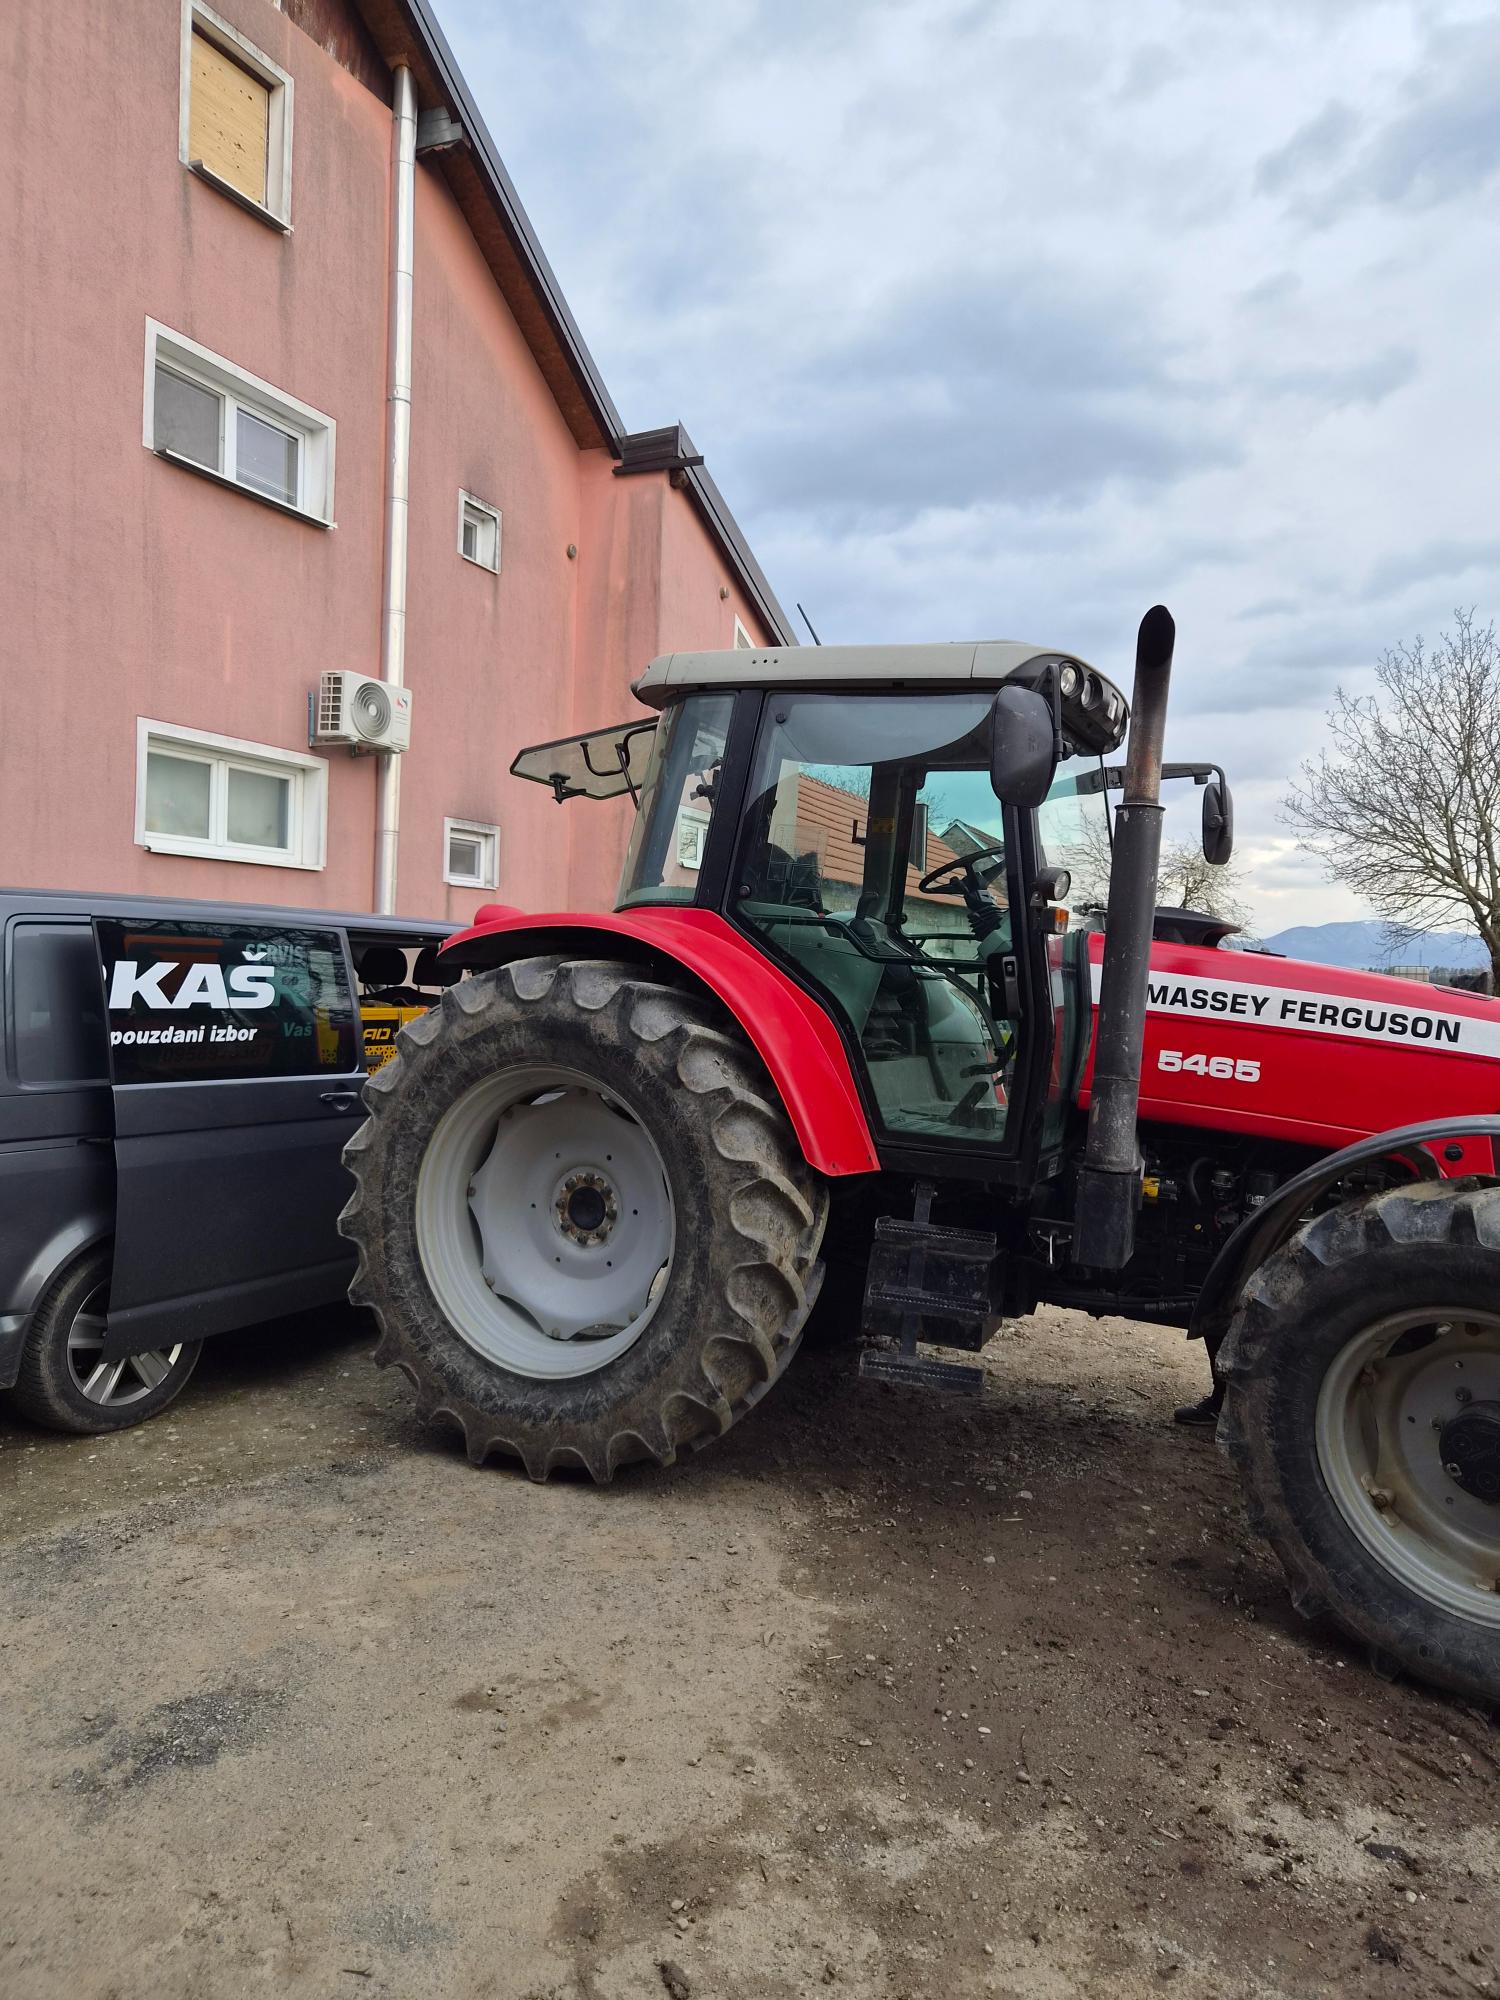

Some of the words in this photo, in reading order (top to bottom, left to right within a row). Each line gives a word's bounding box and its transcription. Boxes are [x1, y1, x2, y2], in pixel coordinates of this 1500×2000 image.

[102, 951, 276, 1009] KAŠ
[283, 1022, 313, 1037] Vaš
[1146, 983, 1271, 1016] MASSEY
[1279, 999, 1462, 1043] FERGUSON
[110, 1025, 206, 1046] pouzdani
[210, 1025, 258, 1042] izbor
[1157, 1049, 1261, 1083] 5465
